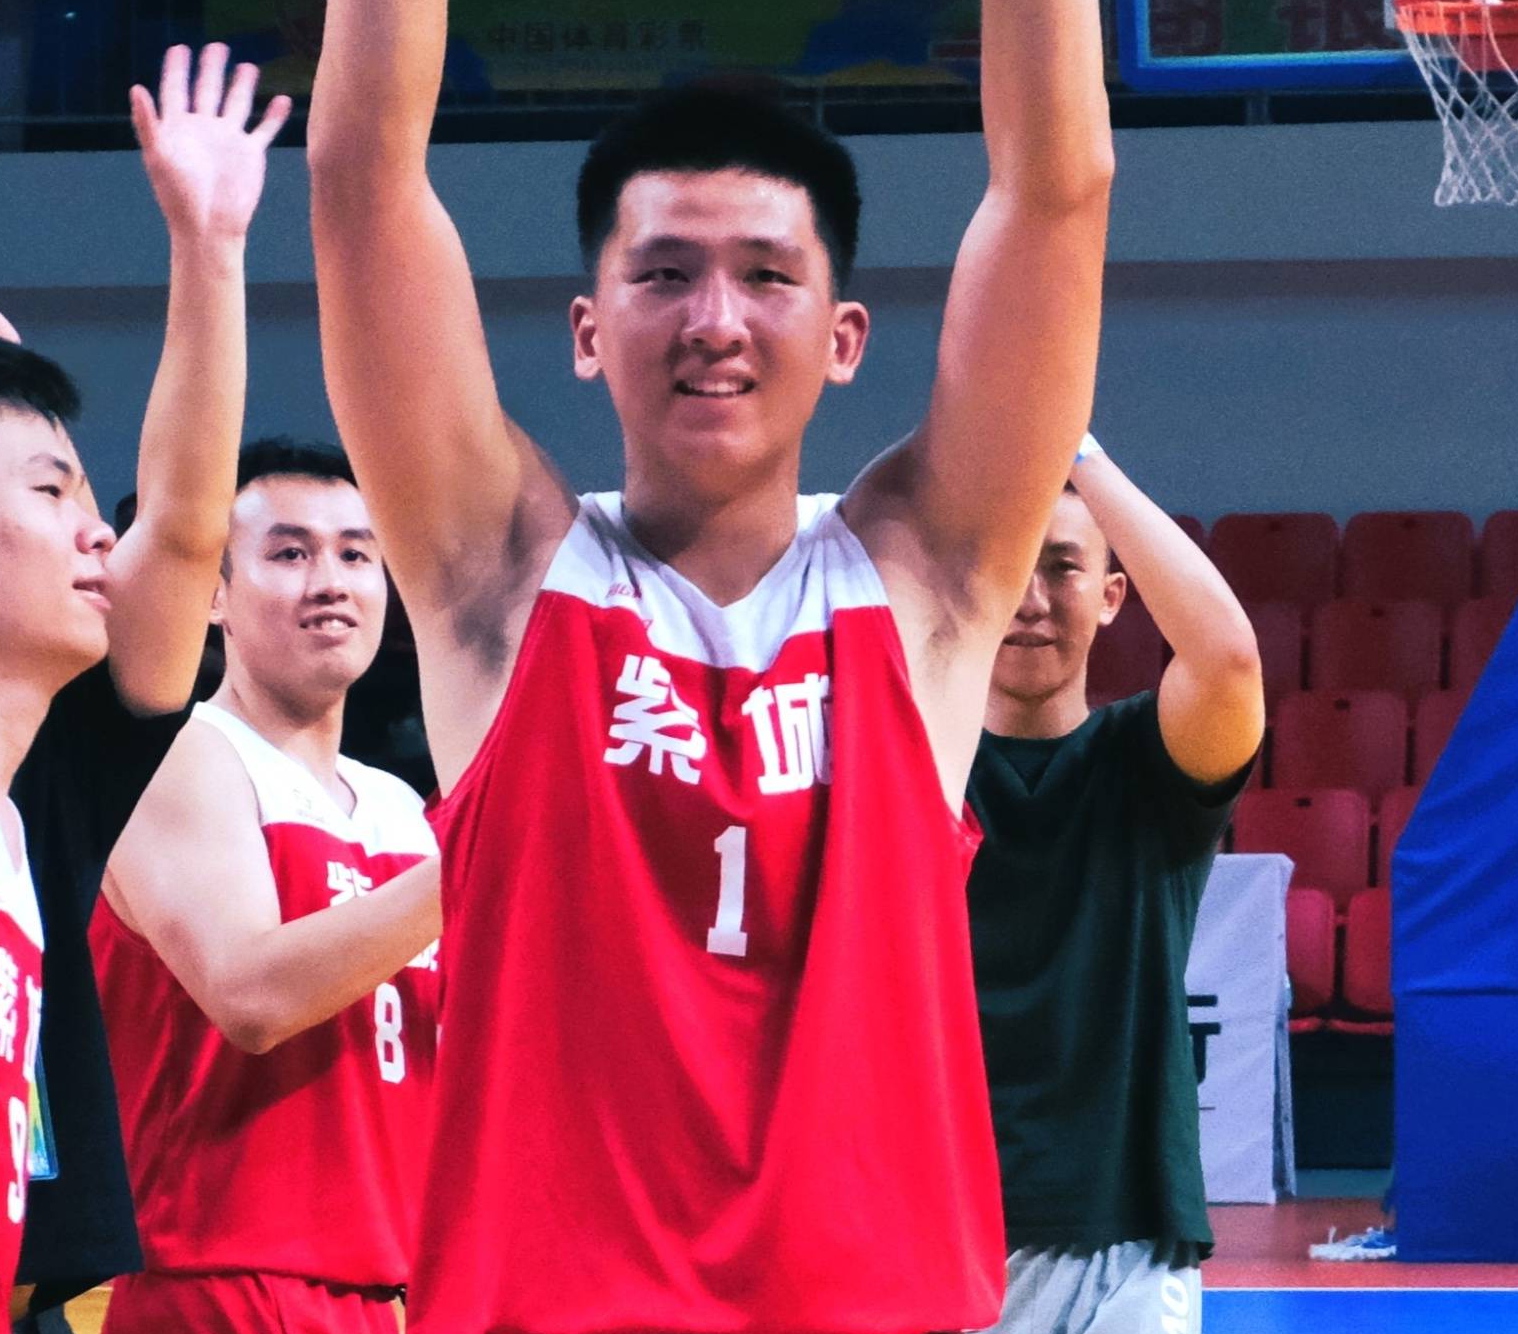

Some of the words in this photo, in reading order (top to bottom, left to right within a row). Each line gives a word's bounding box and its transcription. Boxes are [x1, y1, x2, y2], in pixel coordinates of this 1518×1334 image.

[603, 654, 834, 795] 紫城
[705, 825, 751, 957] 1
[374, 982, 406, 1084] 8
